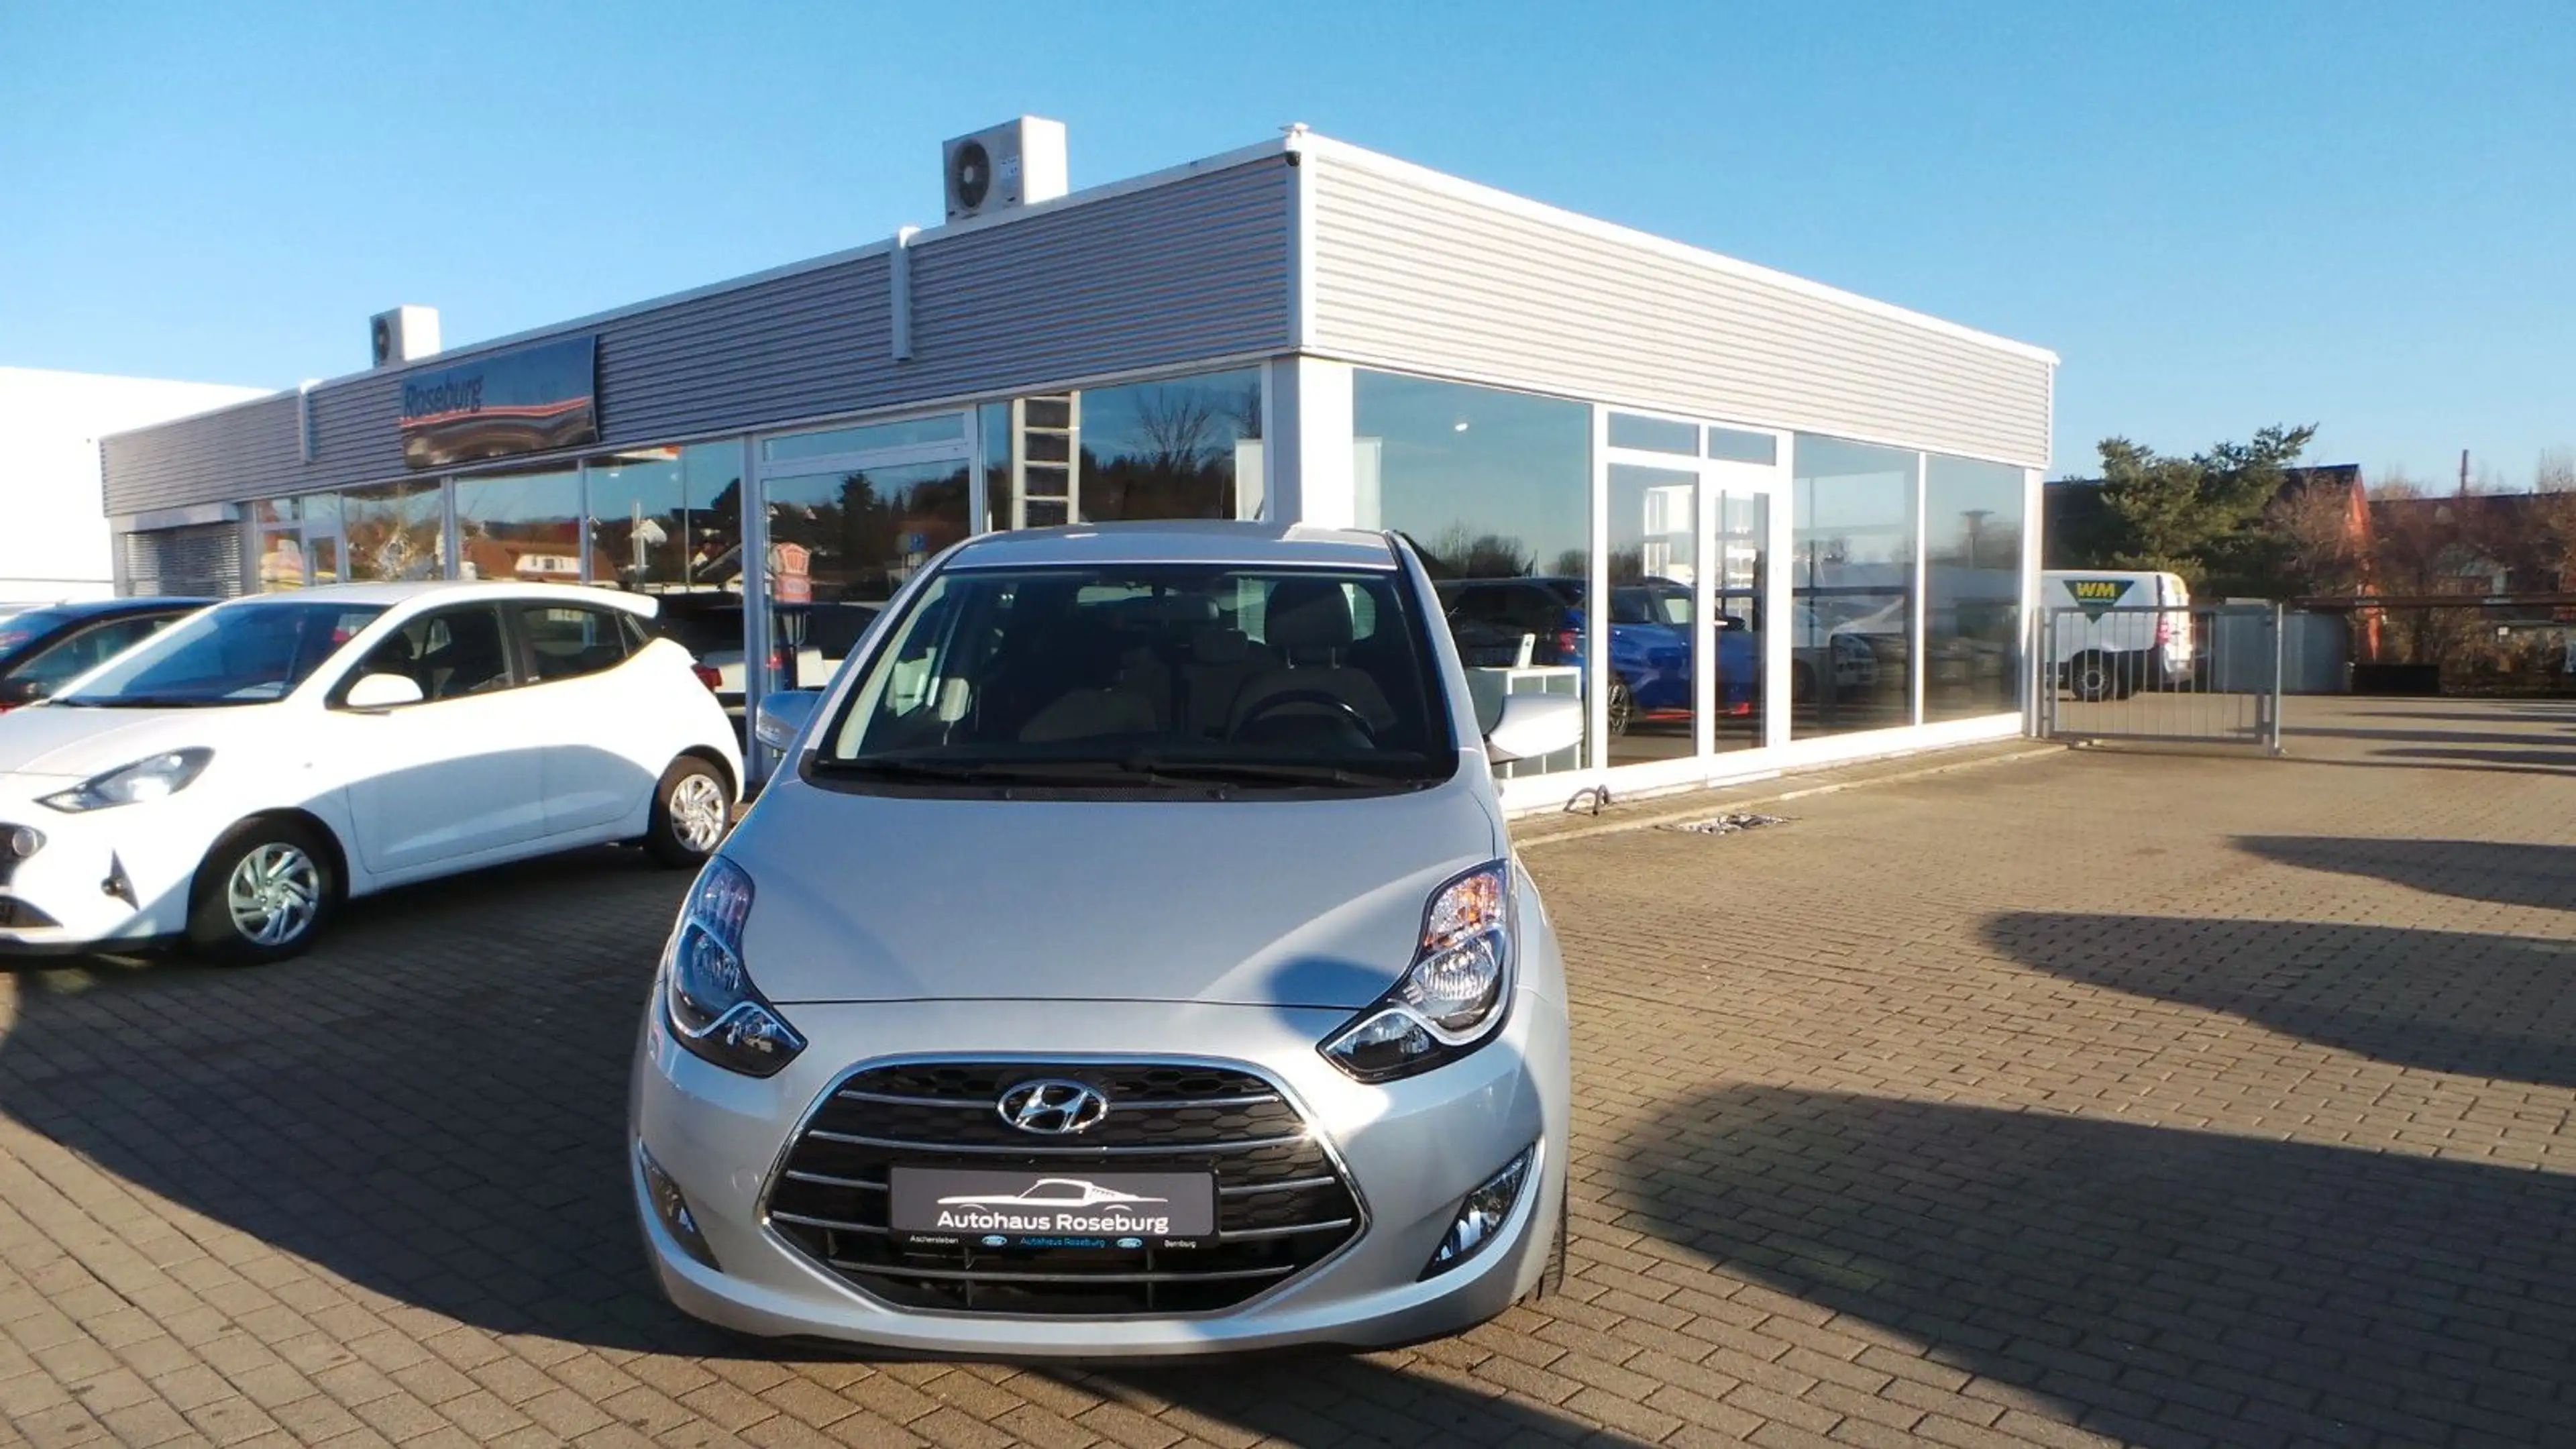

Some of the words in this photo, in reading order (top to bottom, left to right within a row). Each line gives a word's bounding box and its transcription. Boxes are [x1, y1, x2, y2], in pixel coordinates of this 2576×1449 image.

[403, 372, 484, 418] Roseburg
[2076, 582, 2115, 597] WM
[937, 1210, 1051, 1230] Autohaus
[1056, 1214, 1169, 1235] Roseburg
[909, 1234, 959, 1244] Aschersleben
[1064, 1238, 1106, 1249] Roseburg
[1164, 1240, 1197, 1248] Bernburg
